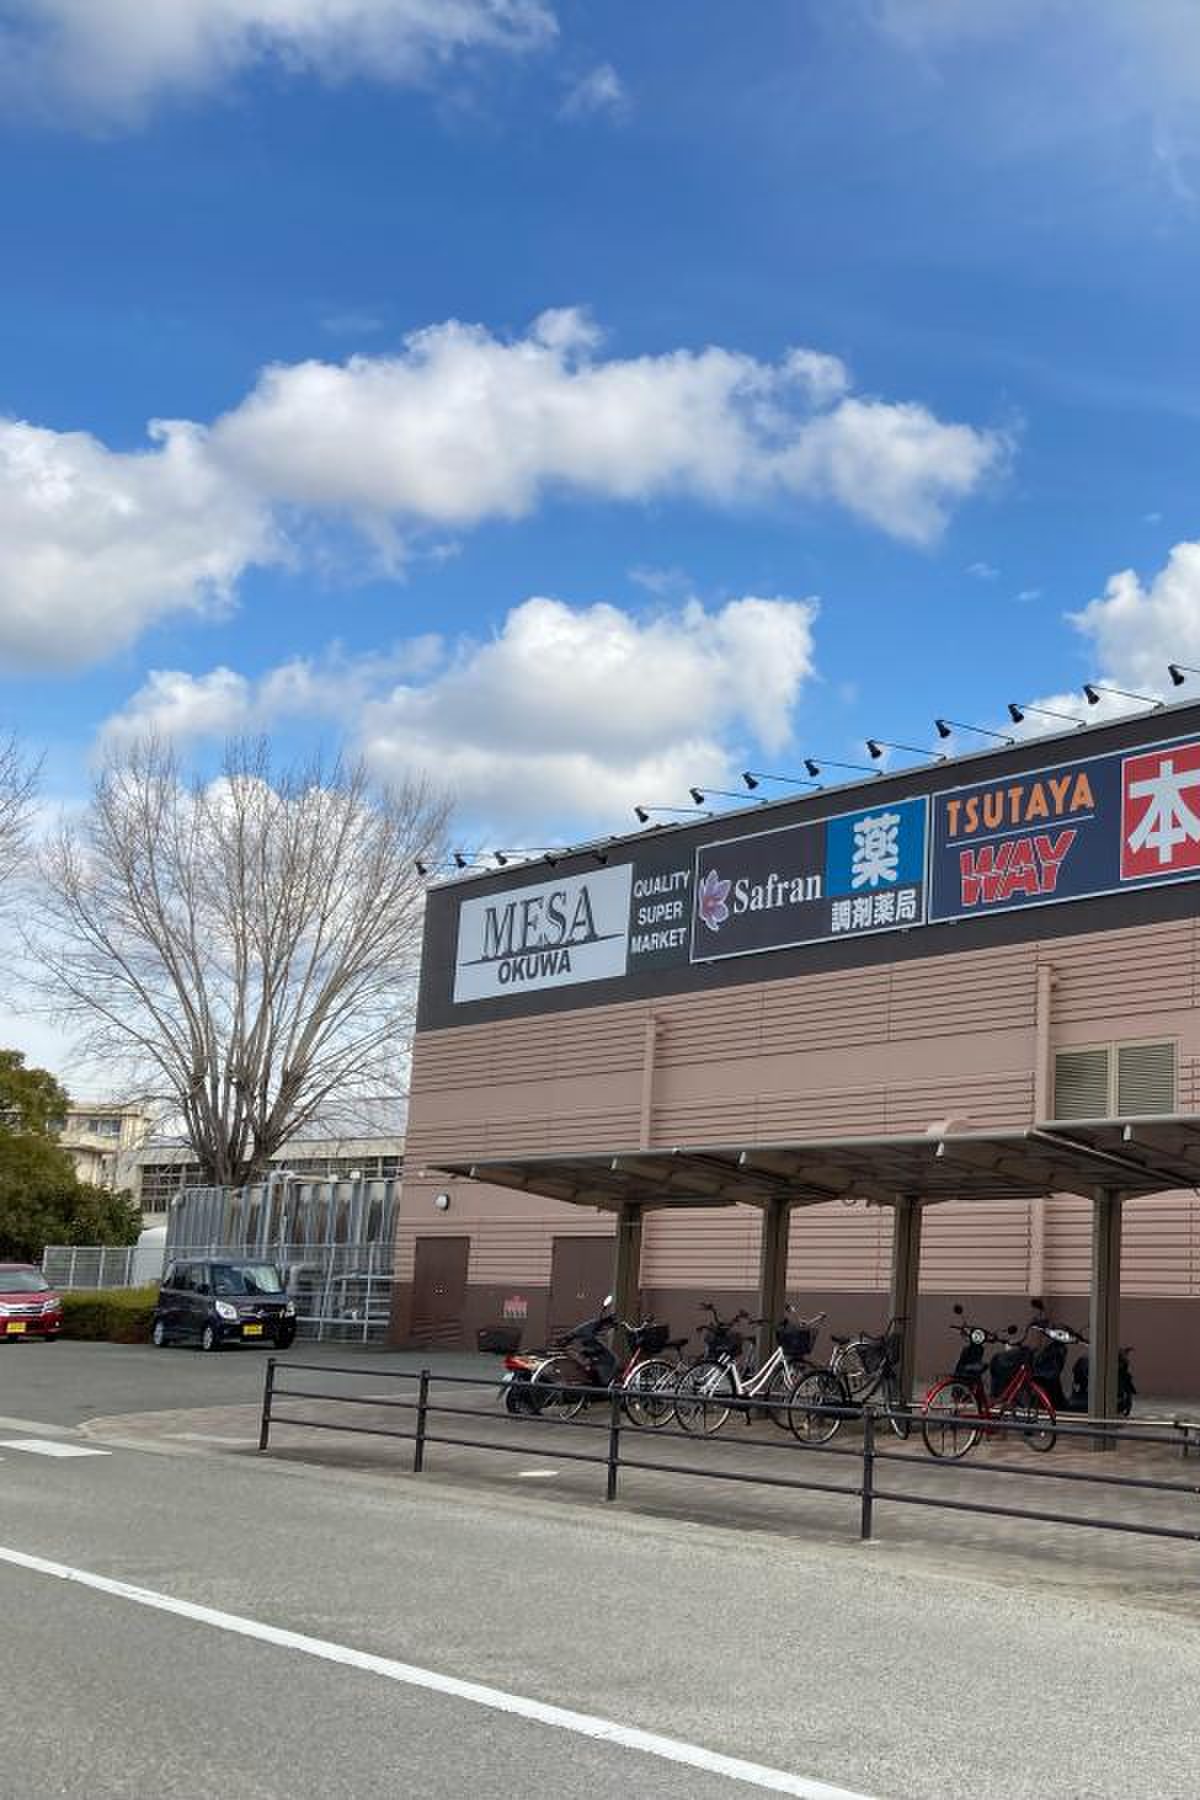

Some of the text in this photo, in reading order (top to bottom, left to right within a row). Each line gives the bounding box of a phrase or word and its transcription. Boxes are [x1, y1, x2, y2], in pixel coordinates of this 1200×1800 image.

[946, 772, 1095, 837] TSUTAYA
[851, 812, 901, 889] 薬
[959, 829, 1077, 906] WAY
[633, 870, 690, 897] QUALITY
[733, 873, 822, 914] Safran
[481, 885, 598, 960] MESA
[637, 901, 683, 925] SUPER
[831, 887, 916, 932] 調剤薬局
[631, 927, 687, 953] MARKET
[498, 949, 571, 984] OKUWA
